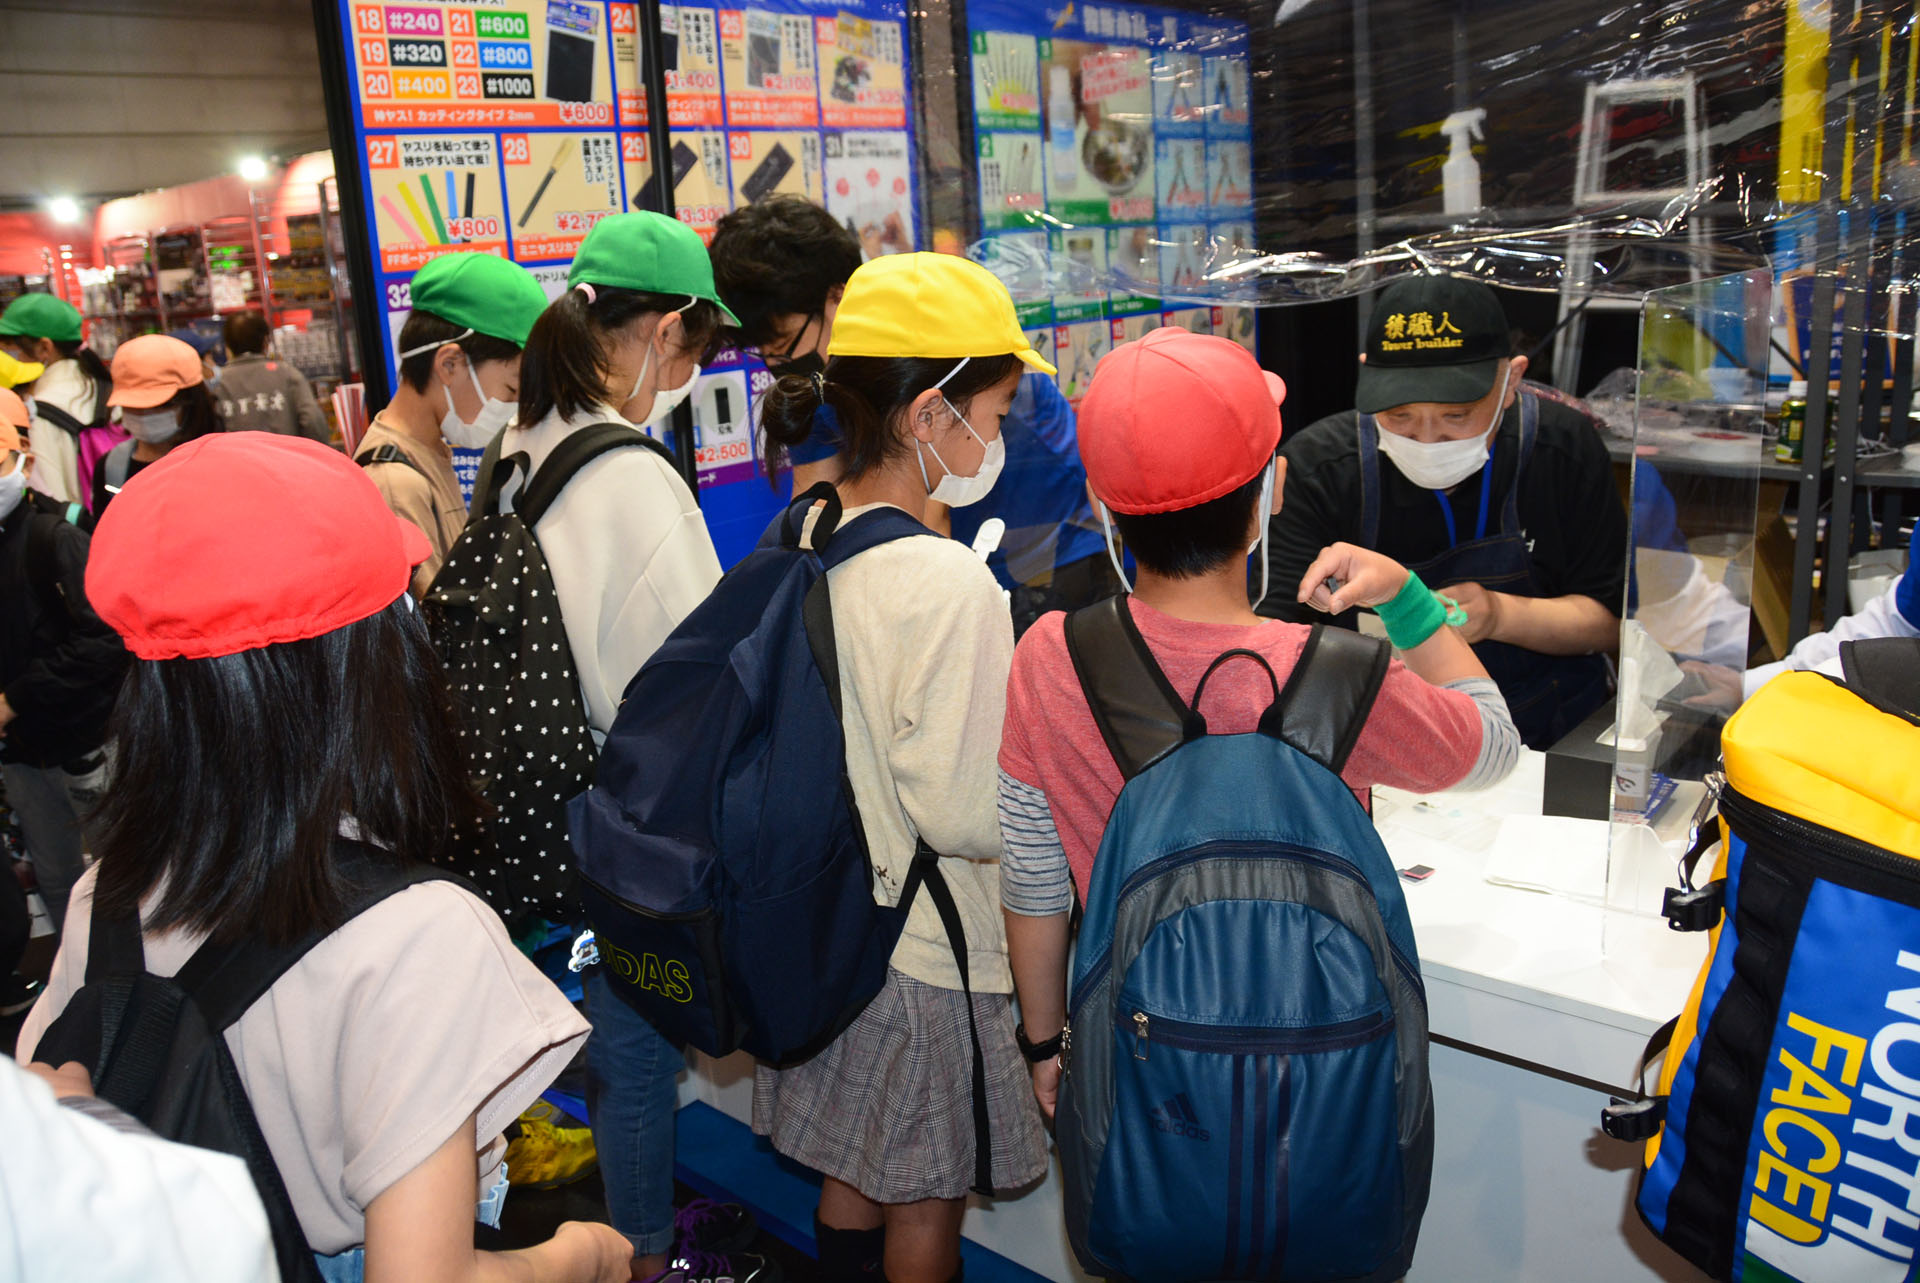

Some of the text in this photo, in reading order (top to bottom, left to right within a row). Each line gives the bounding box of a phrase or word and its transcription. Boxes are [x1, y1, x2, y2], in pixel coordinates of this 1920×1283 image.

[357, 9, 381, 29] 18
[388, 11, 441, 31] #240
[451, 13, 471, 33] 21
[479, 16, 526, 35] #600
[612, 7, 634, 30] 24
[362, 42, 385, 62] 19
[393, 43, 443, 62] #320
[454, 44, 476, 64] 22
[483, 47, 529, 64] #800
[366, 76, 390, 95] 20
[397, 77, 447, 94] #400
[457, 76, 479, 95] 23
[486, 78, 532, 95] #1000
[507, 110, 535, 122] 2mm
[560, 103, 608, 121] ¥600
[369, 140, 394, 164] 27
[403, 139, 490, 152] ヤスリを貼って使う
[504, 139, 528, 161] 28
[623, 136, 645, 158] 29
[731, 136, 750, 156] 30
[404, 153, 489, 167] 持ちやすい当て板!
[448, 219, 498, 238] ¥800
[387, 284, 411, 309] 32
[1381, 337, 1464, 352] Tower builder
[750, 371, 769, 392] 38
[1753, 1011, 1868, 1223] FACE
